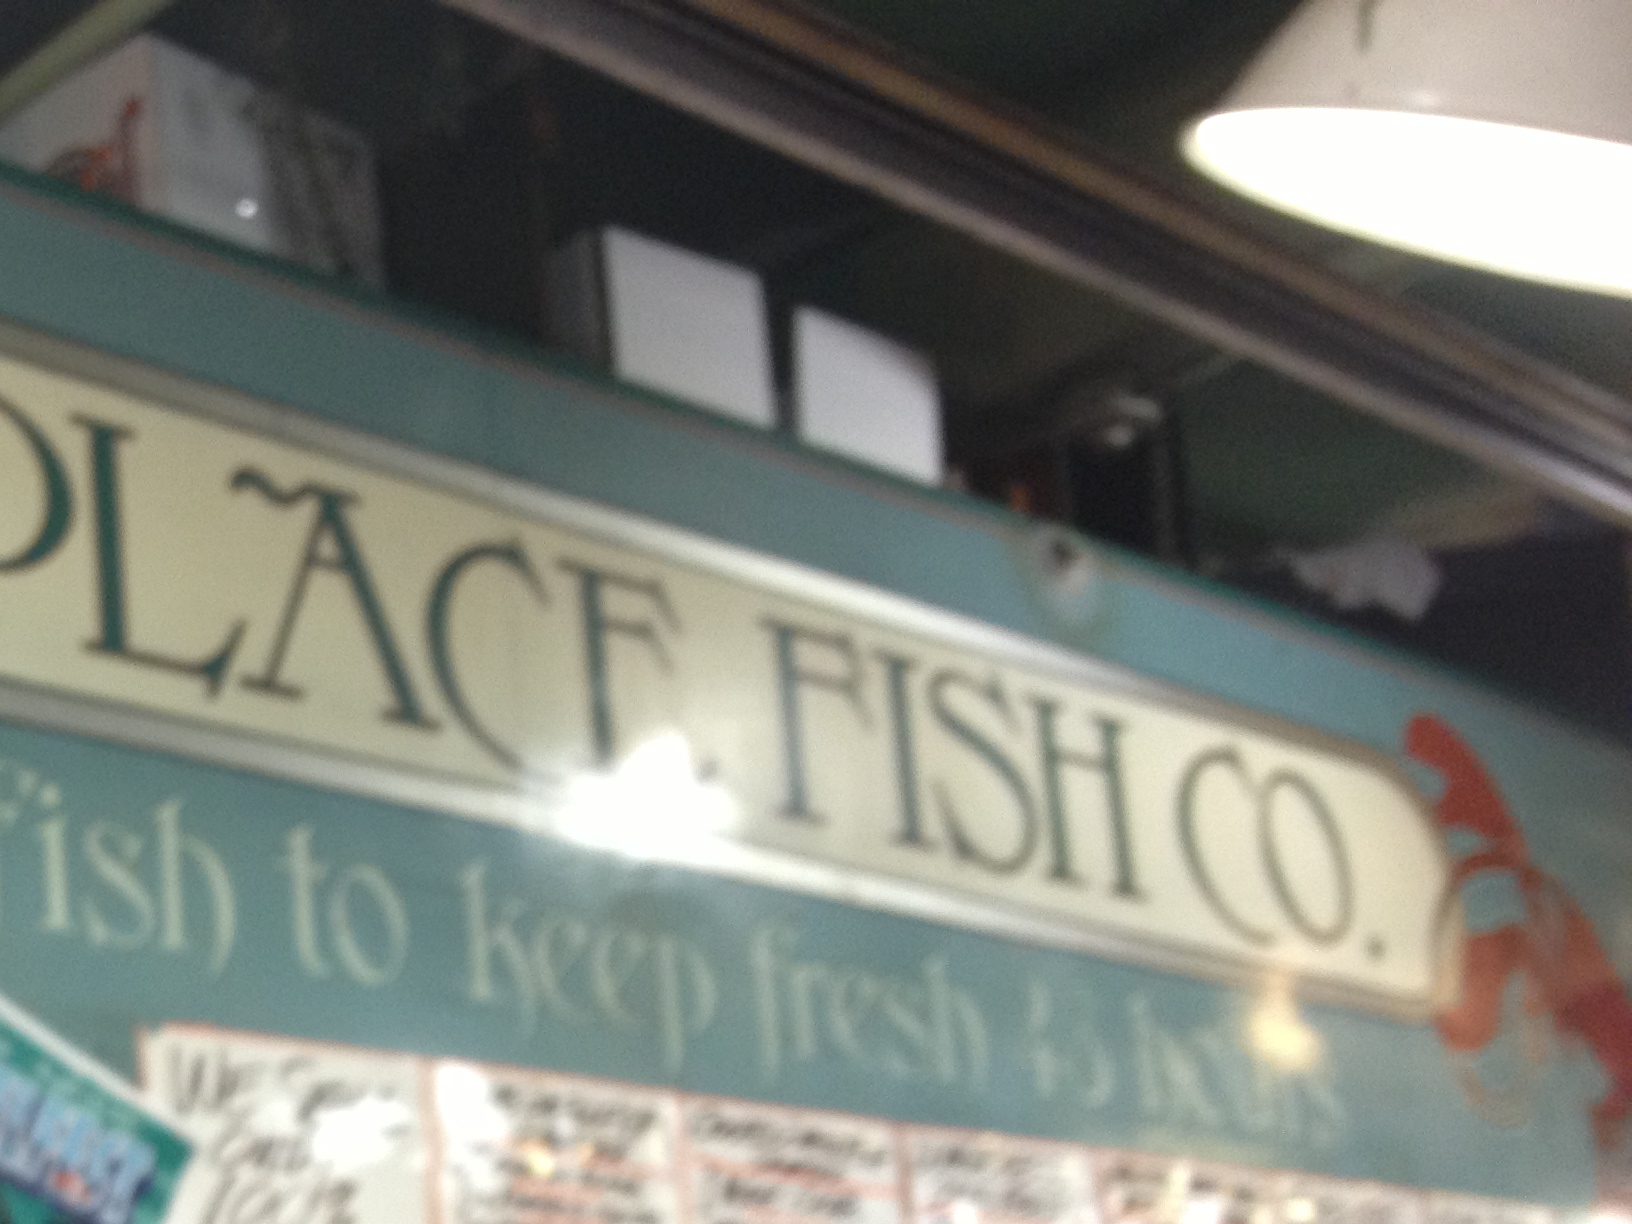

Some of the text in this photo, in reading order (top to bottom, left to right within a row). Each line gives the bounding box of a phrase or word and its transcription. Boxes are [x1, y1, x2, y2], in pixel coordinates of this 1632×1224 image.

[758, 614, 1150, 903] FISH
[1174, 744, 1385, 960] CO.
[281, 822, 413, 988] to
[460, 857, 721, 1072] keep
[748, 921, 989, 1095] fresh
